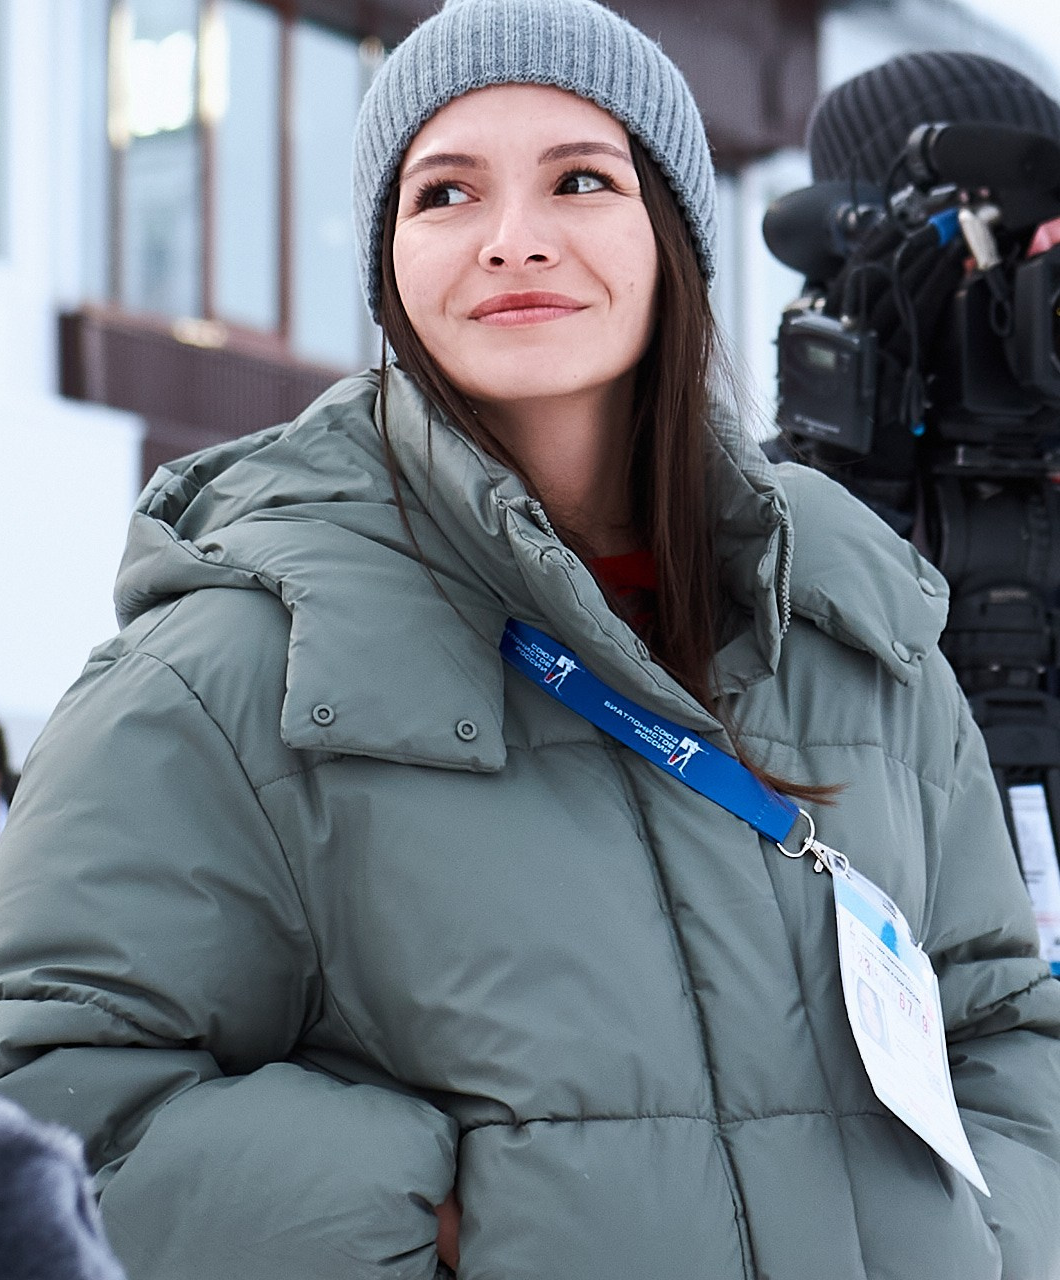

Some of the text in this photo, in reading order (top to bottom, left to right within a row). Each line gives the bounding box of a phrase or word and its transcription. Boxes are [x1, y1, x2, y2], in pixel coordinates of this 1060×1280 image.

[516, 646, 548, 673] РОССИИ
[531, 643, 555, 663] СОЮЗ
[603, 700, 675, 750] БИАТЛОНИСТОВ
[653, 725, 679, 745] СОЮЗ
[634, 728, 671, 755] РОССИИ
